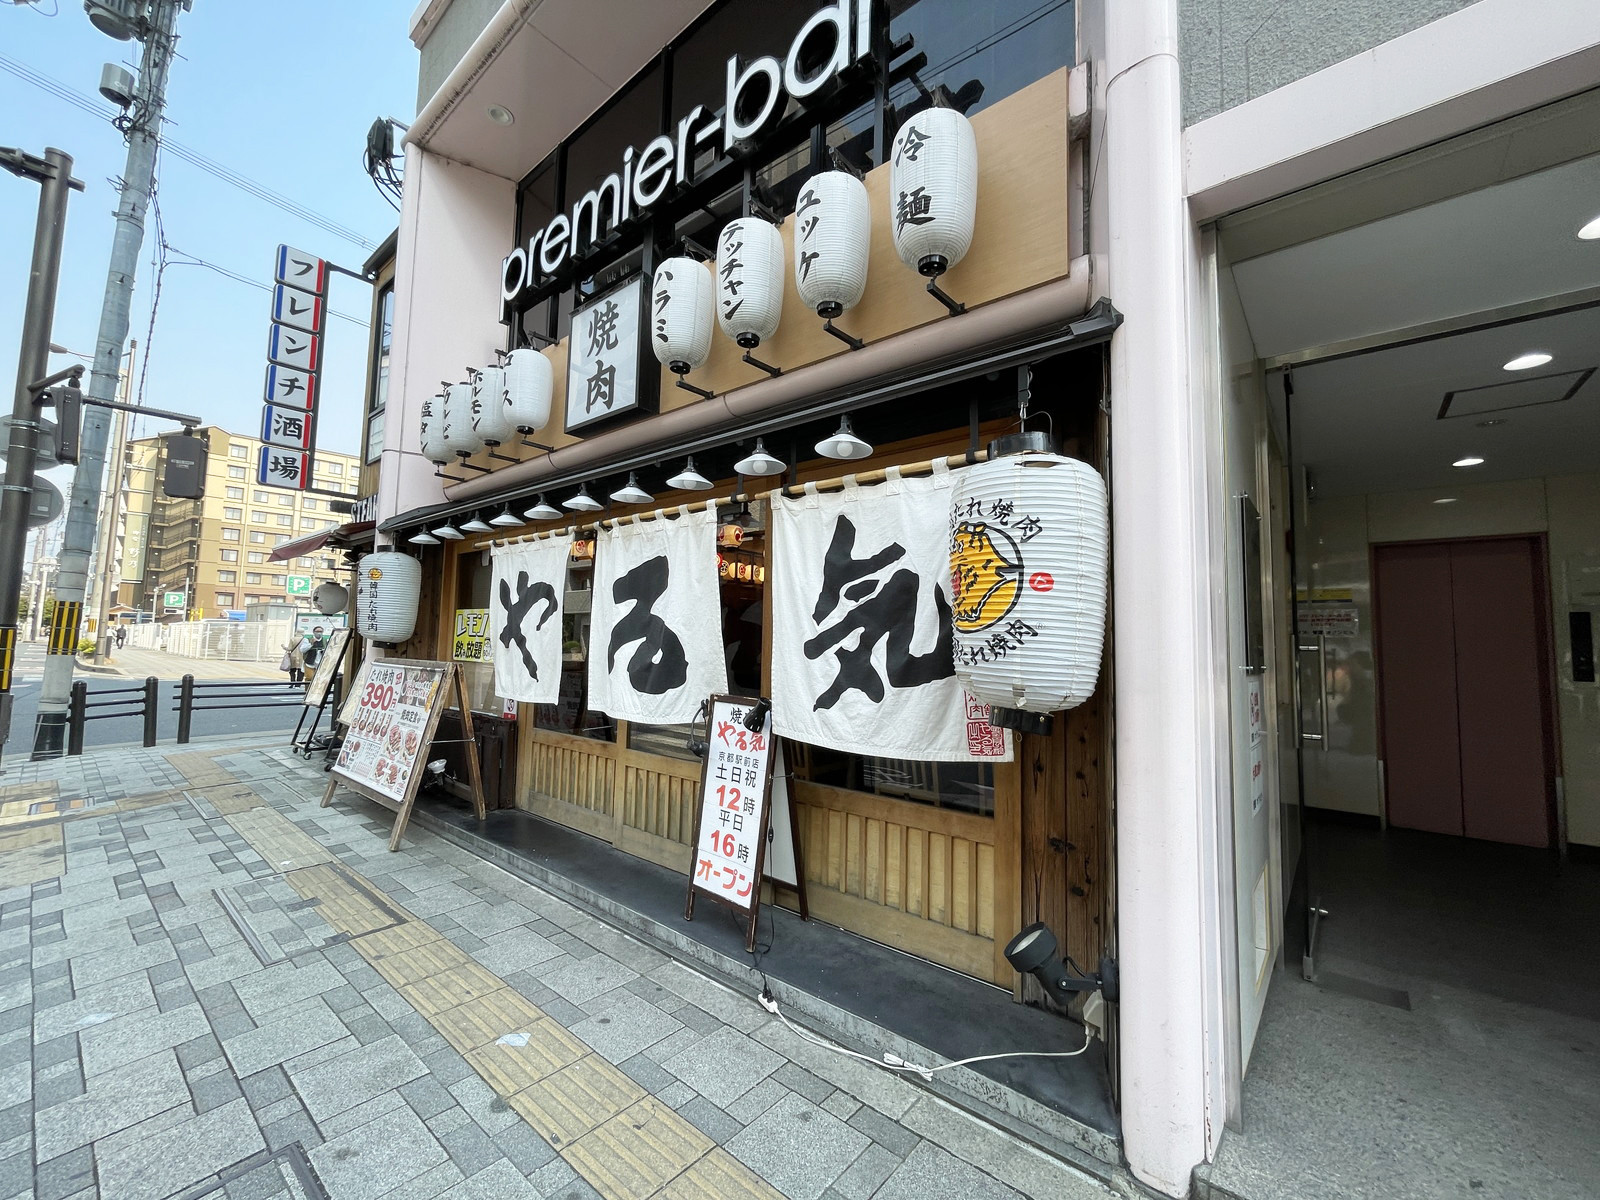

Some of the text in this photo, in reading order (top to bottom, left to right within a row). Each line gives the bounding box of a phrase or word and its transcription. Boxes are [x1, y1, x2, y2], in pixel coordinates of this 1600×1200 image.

[796, 189, 822, 284] ユッケ
[720, 223, 744, 320] テッチャン
[654, 271, 674, 343] ハラミ
[269, 259, 314, 481] フレンチ酒場
[586, 300, 619, 414] 焼肉
[169, 595, 179, 604] P
[293, 578, 305, 591] P
[361, 682, 394, 711] 390
[717, 721, 766, 752] やる気
[715, 763, 757, 788] 土日祝
[718, 751, 760, 769] 京都駅前店
[716, 785, 755, 816] 12時
[718, 810, 744, 833] 平日
[710, 830, 750, 863] 16時
[697, 859, 753, 897] オープン
